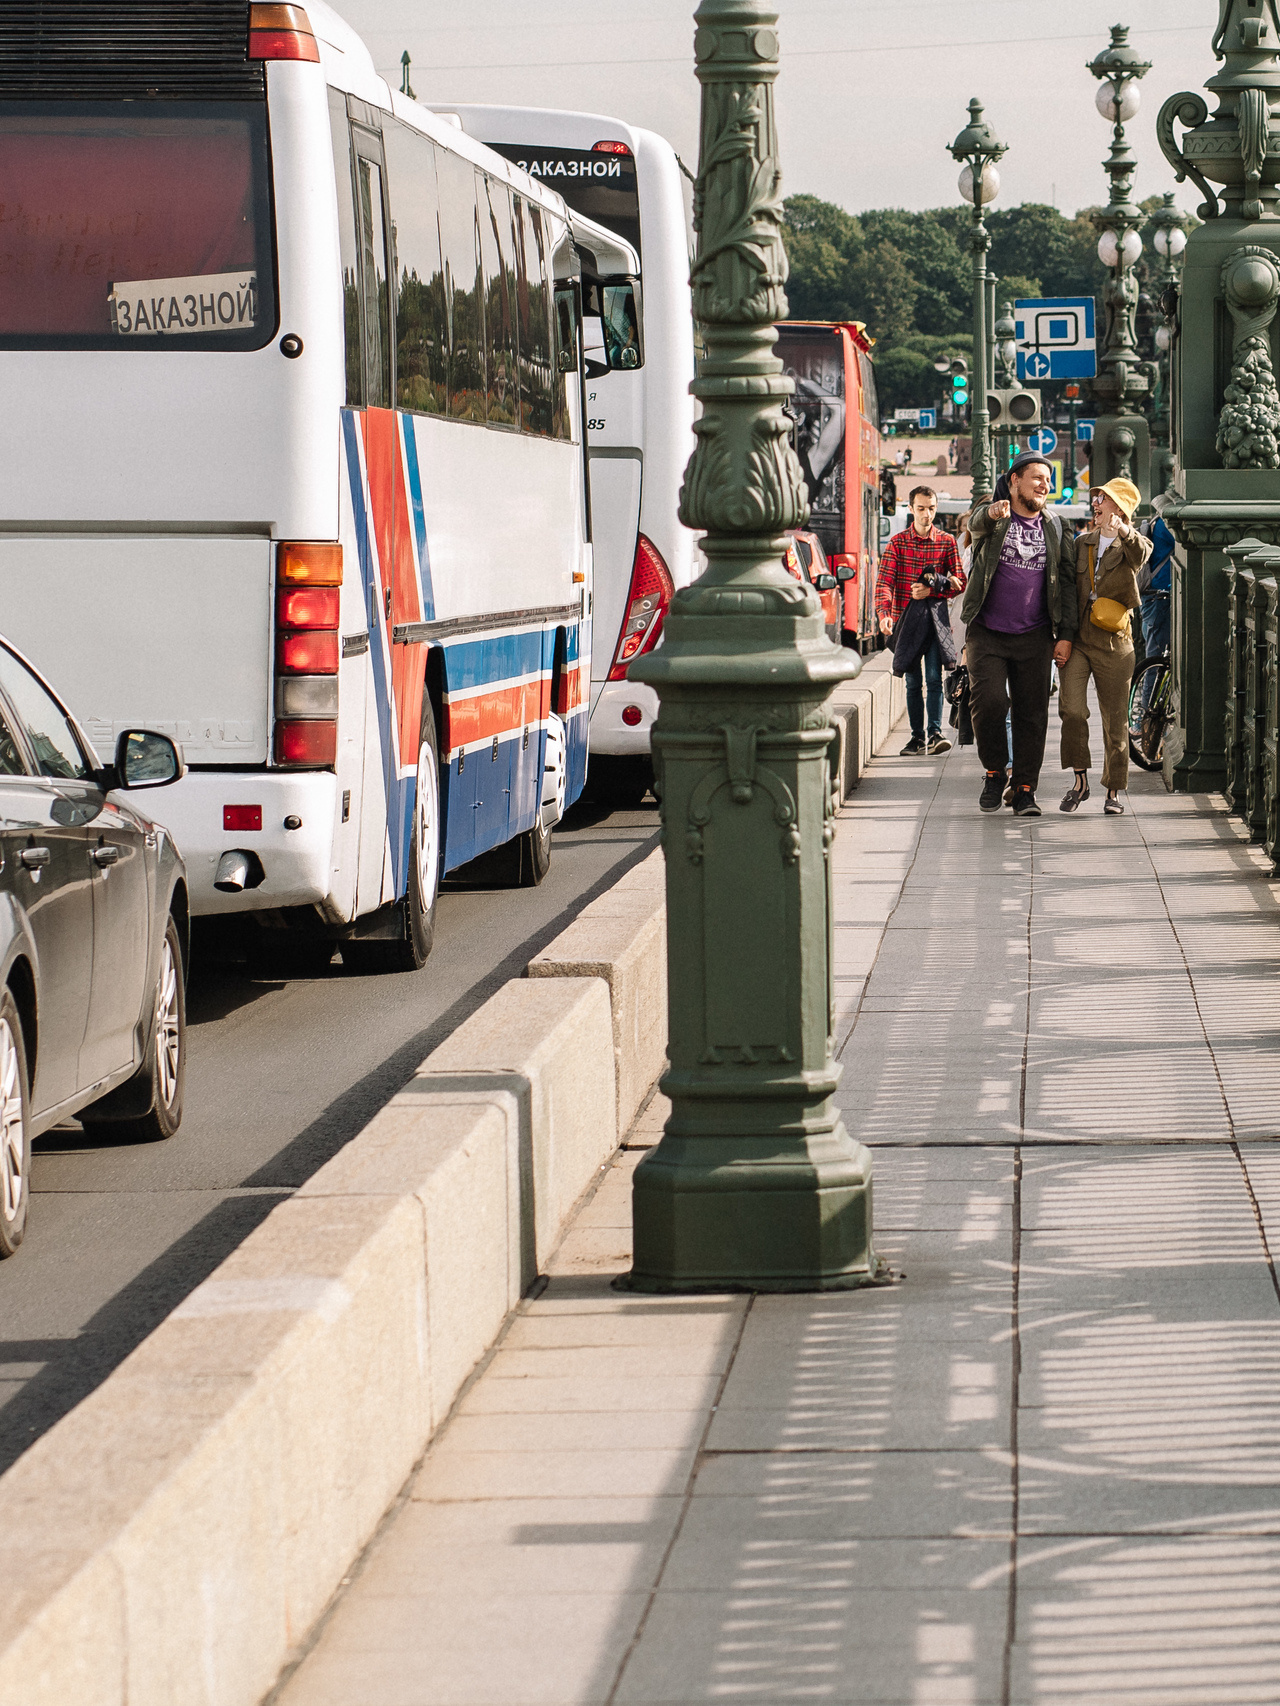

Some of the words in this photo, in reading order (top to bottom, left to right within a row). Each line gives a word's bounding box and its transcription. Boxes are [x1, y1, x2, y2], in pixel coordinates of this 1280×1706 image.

[516, 158, 621, 177] ЗАКАЗНОЙ
[117, 282, 252, 333] ЗАКАЗНОЙ
[587, 418, 606, 430] 85
